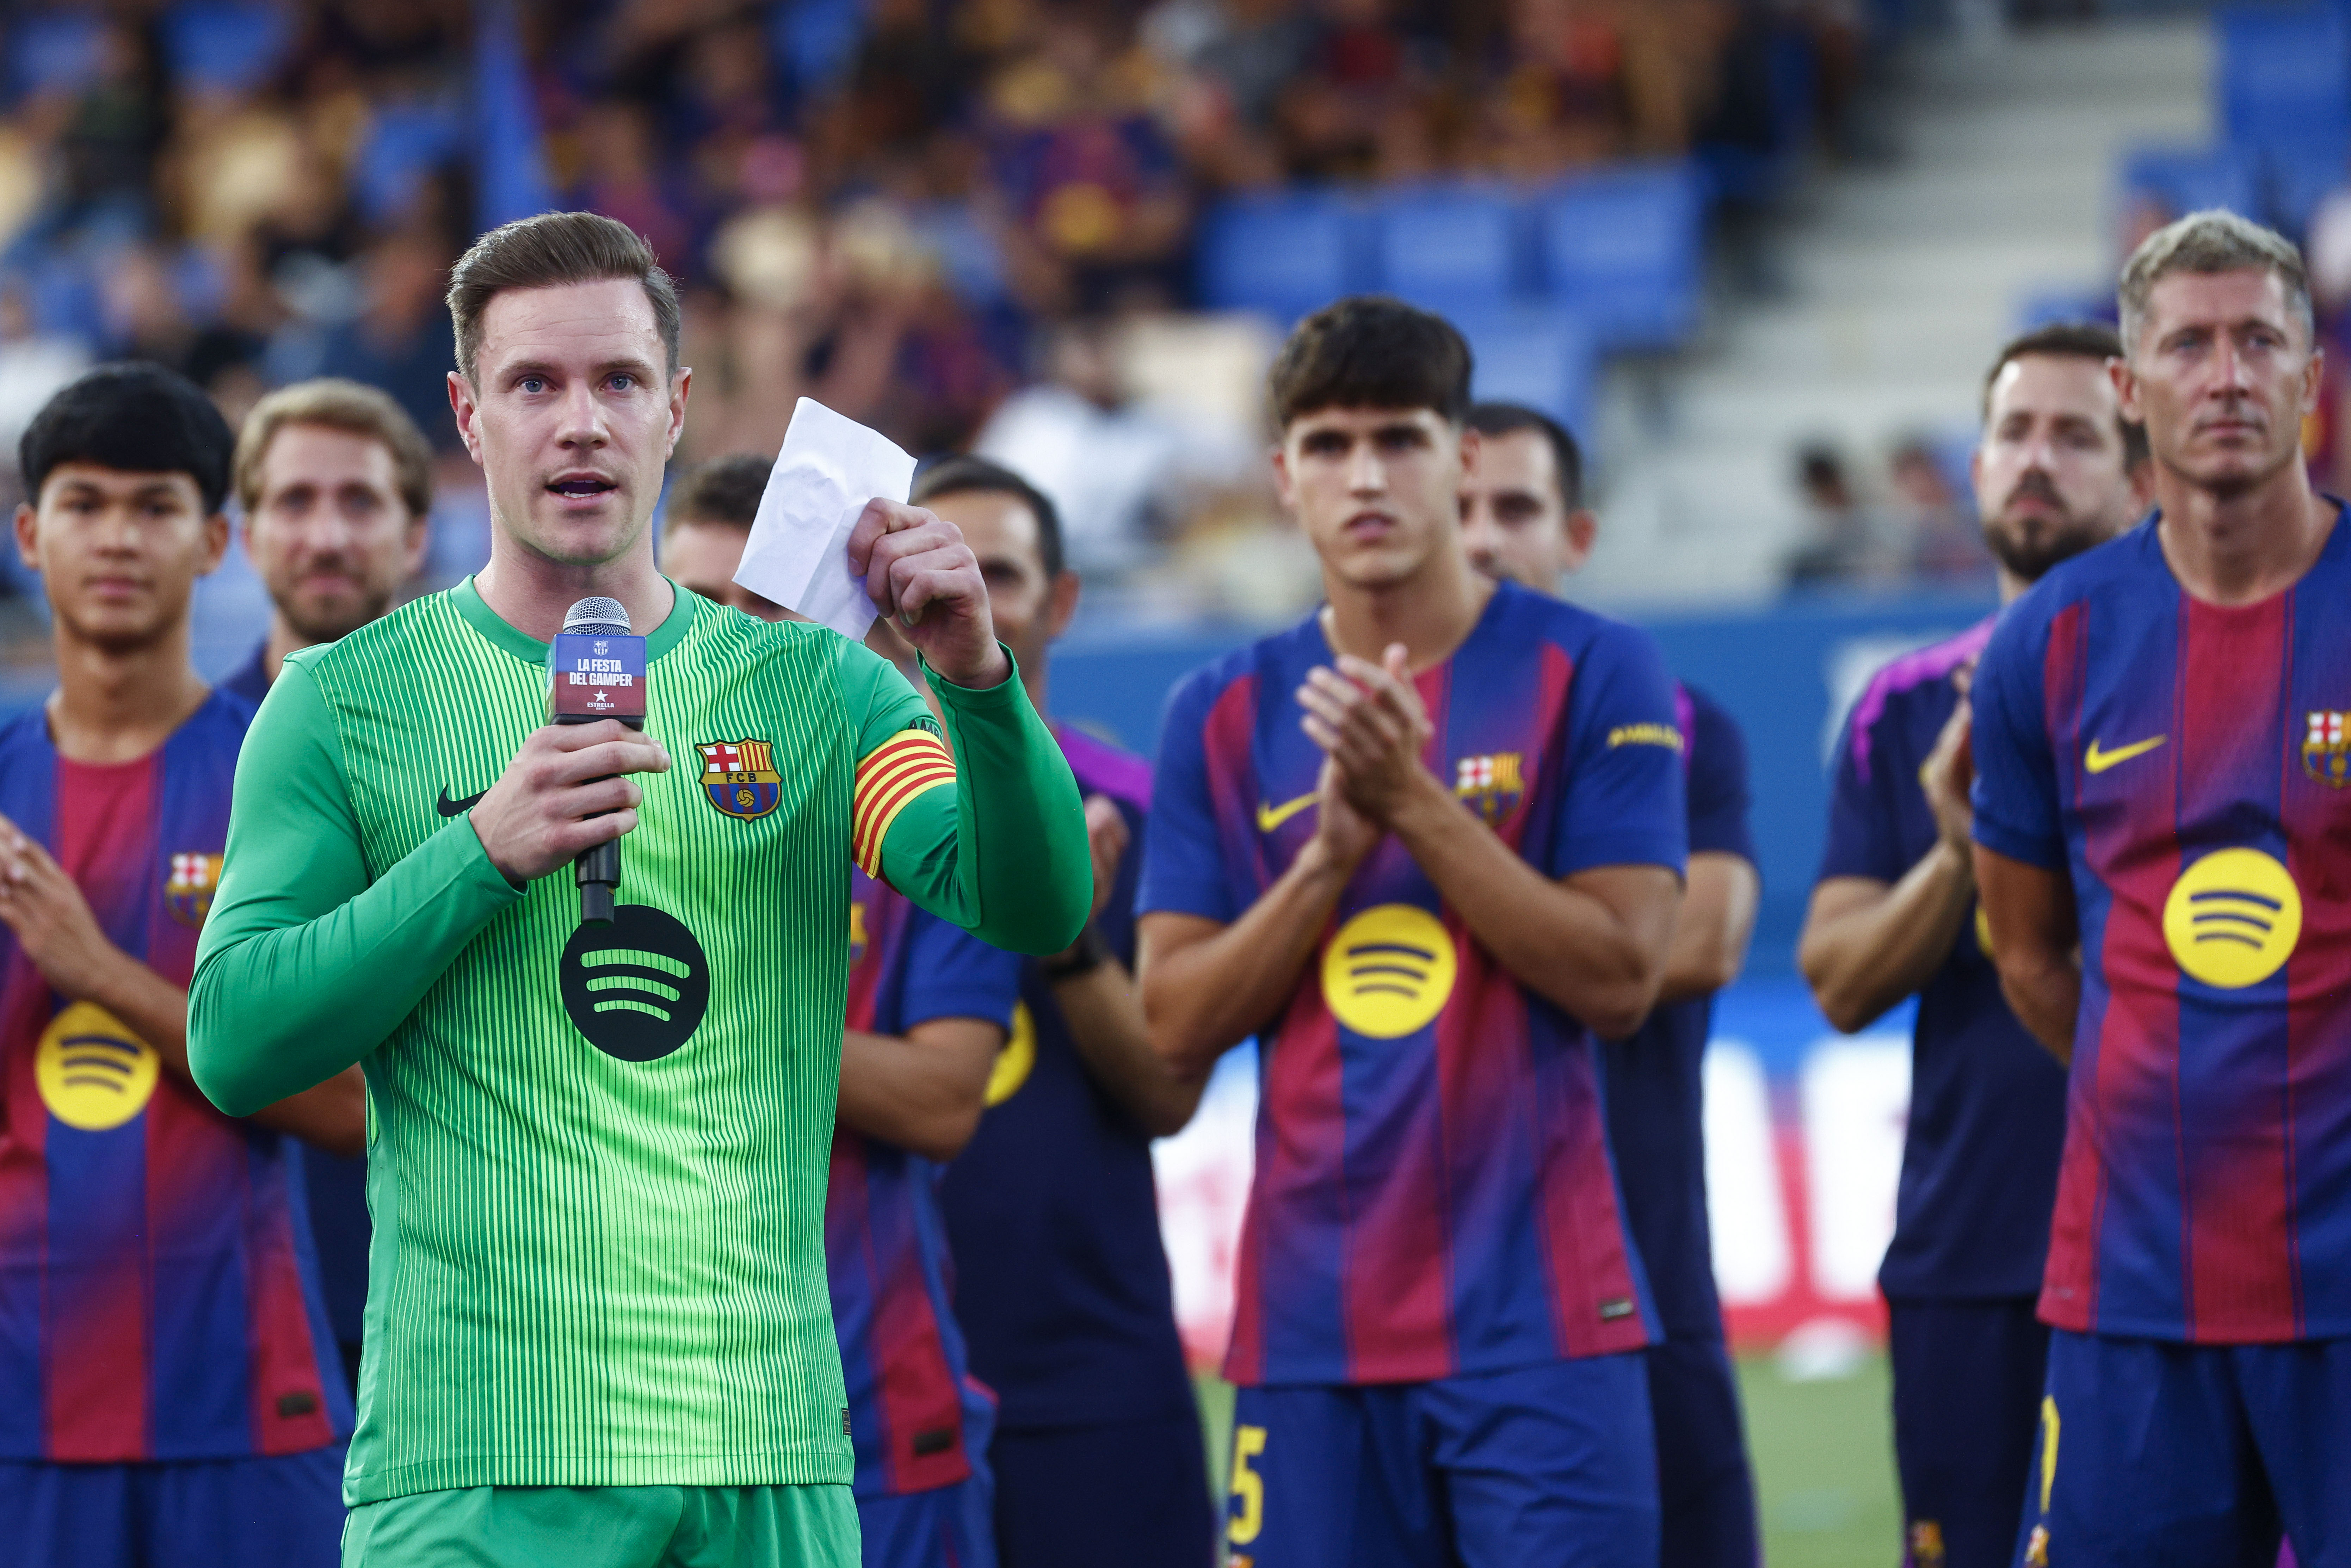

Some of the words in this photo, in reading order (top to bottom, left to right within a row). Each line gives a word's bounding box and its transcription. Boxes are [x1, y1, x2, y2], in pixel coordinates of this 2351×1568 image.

[578, 659, 590, 671] LA
[592, 659, 622, 672] FESTA
[569, 672, 588, 685] DEL
[589, 673, 633, 686] GAMPER
[726, 772, 757, 783] FCB
